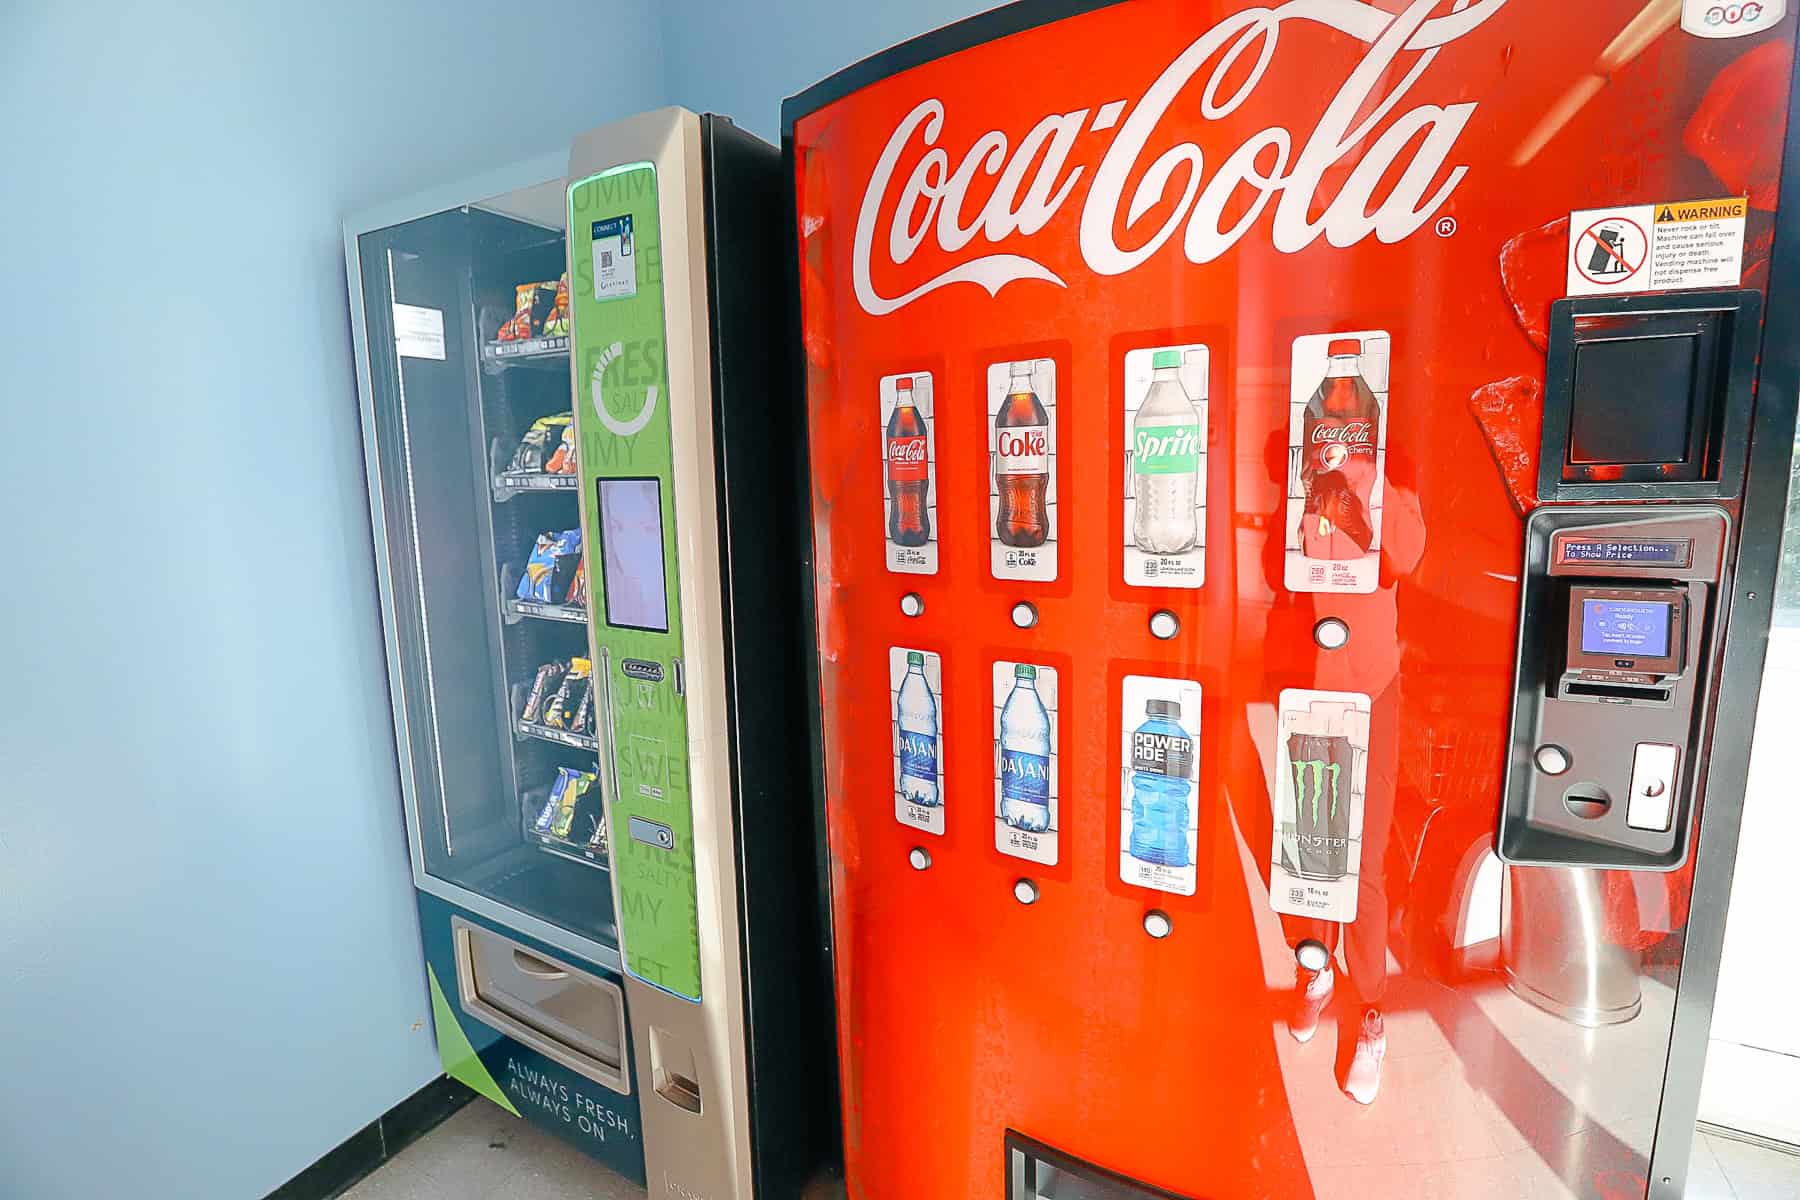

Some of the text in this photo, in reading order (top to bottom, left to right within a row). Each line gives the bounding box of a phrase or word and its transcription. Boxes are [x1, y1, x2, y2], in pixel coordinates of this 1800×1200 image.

[852, 0, 1504, 316] Coca-Cola
[1678, 205, 1742, 220] WARNING
[1657, 233, 1688, 241] Machine
[1696, 240, 1724, 248] serious
[1655, 252, 1677, 260] injury
[1668, 267, 1702, 275] dispense
[1312, 422, 1372, 444] Coca-Cola
[889, 439, 925, 462] Coca-Cola
[998, 431, 1046, 457] Coke
[1566, 543, 1592, 551] Press
[1606, 551, 1633, 559] Price
[1134, 732, 1190, 753] POWER
[1134, 746, 1165, 762] ADE
[507, 1058, 569, 1102] ALWAYS
[510, 1078, 606, 1143] ALWAYS ON
